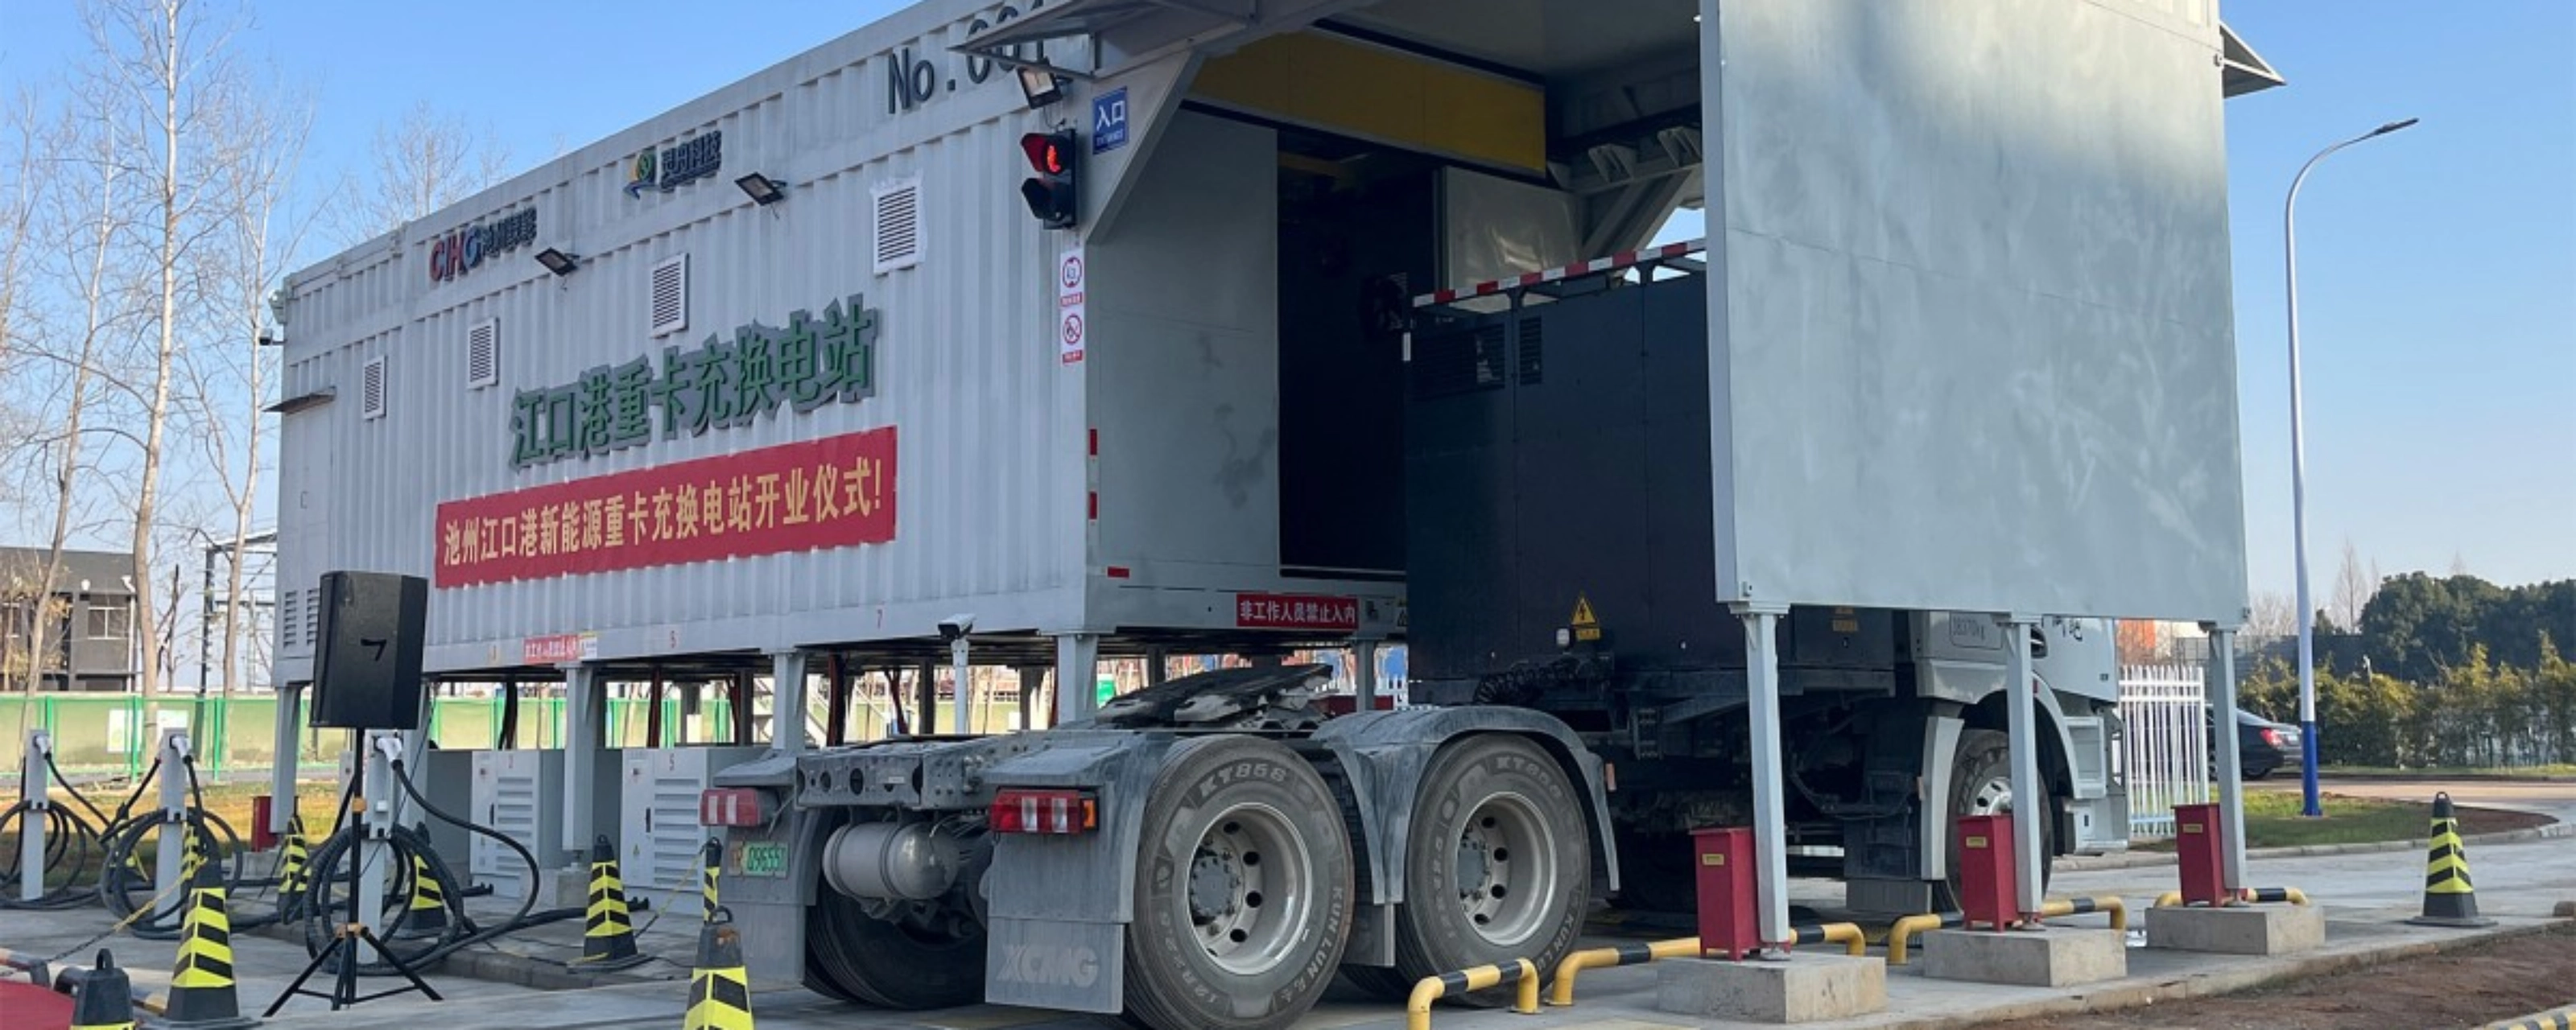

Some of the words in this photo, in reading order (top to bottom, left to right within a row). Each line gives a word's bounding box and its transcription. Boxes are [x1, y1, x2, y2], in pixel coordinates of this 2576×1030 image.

[1096, 101, 1125, 131] 入口
[510, 301, 875, 465] 江口港重卡充换电站
[1240, 600, 1356, 623] 非工作人员禁止入内
[996, 944, 1100, 988] XCMG
